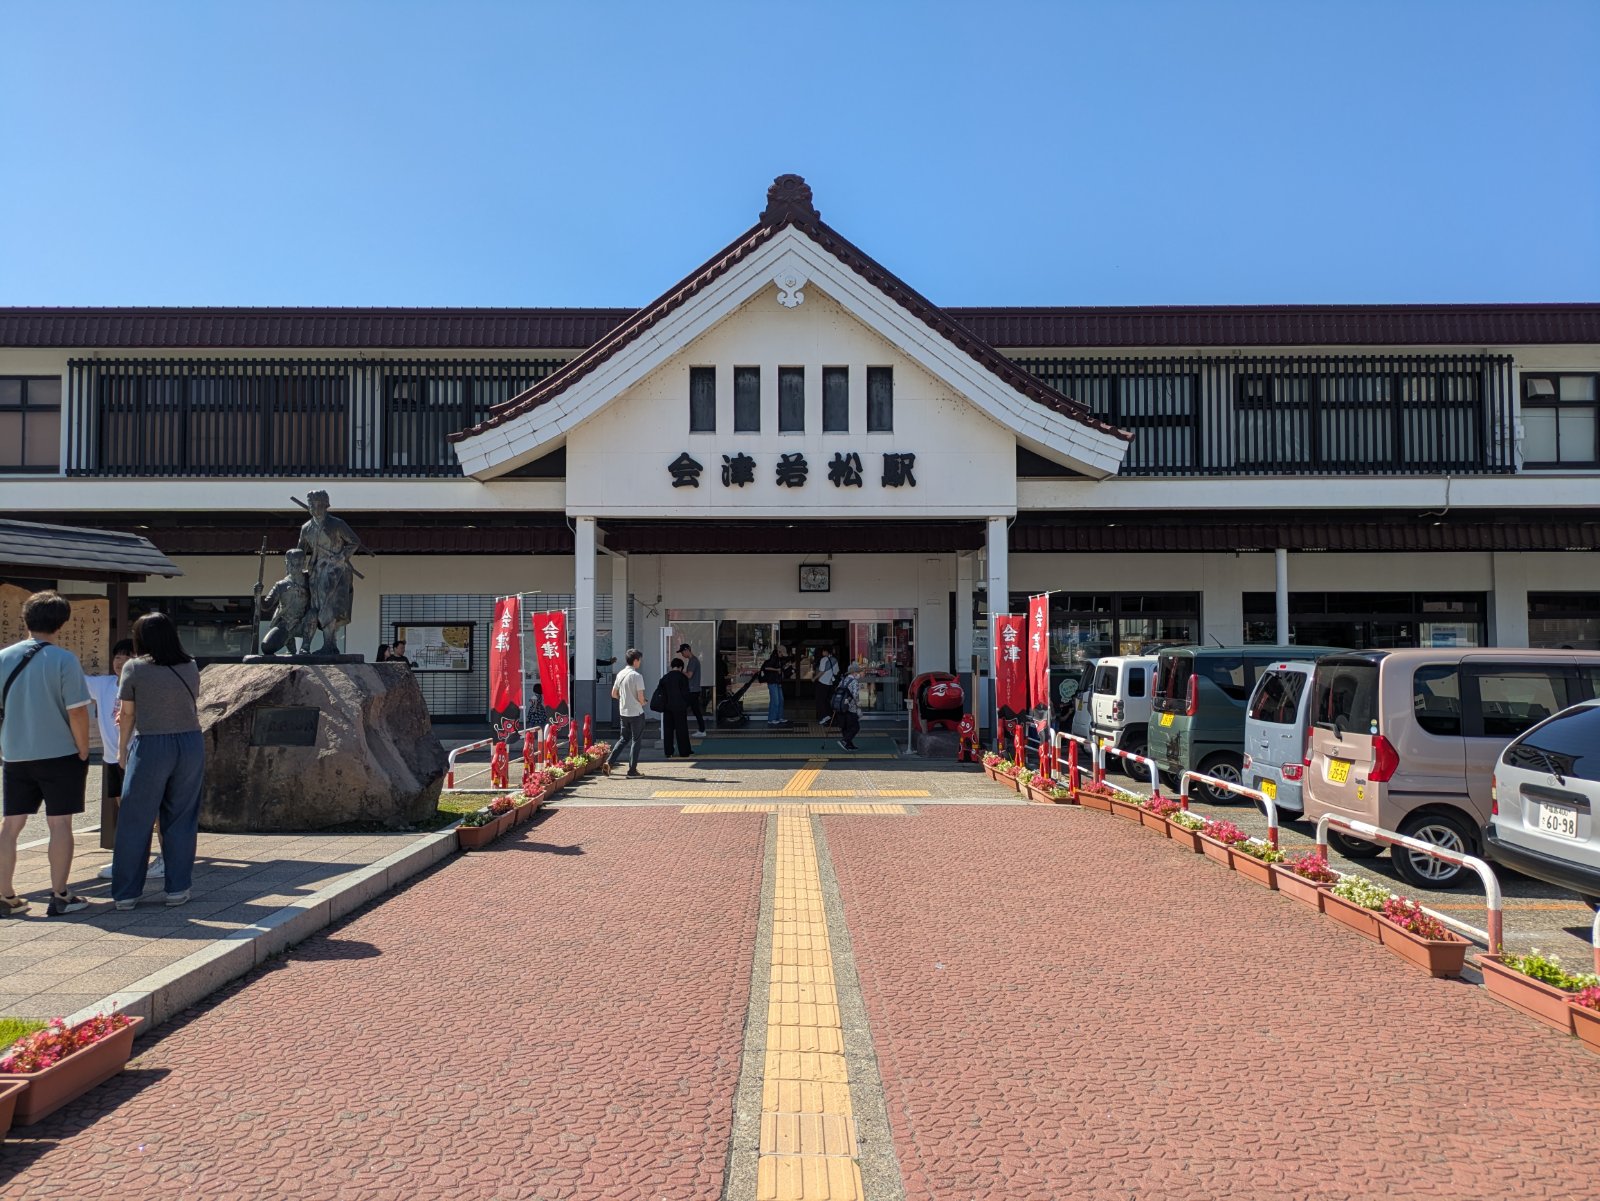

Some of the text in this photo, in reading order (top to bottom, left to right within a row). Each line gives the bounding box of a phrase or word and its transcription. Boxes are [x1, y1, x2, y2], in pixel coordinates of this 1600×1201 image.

[668, 452, 917, 488] 会津若松駅
[1002, 623, 1021, 663] 会津
[1546, 815, 1574, 834] 60-98
